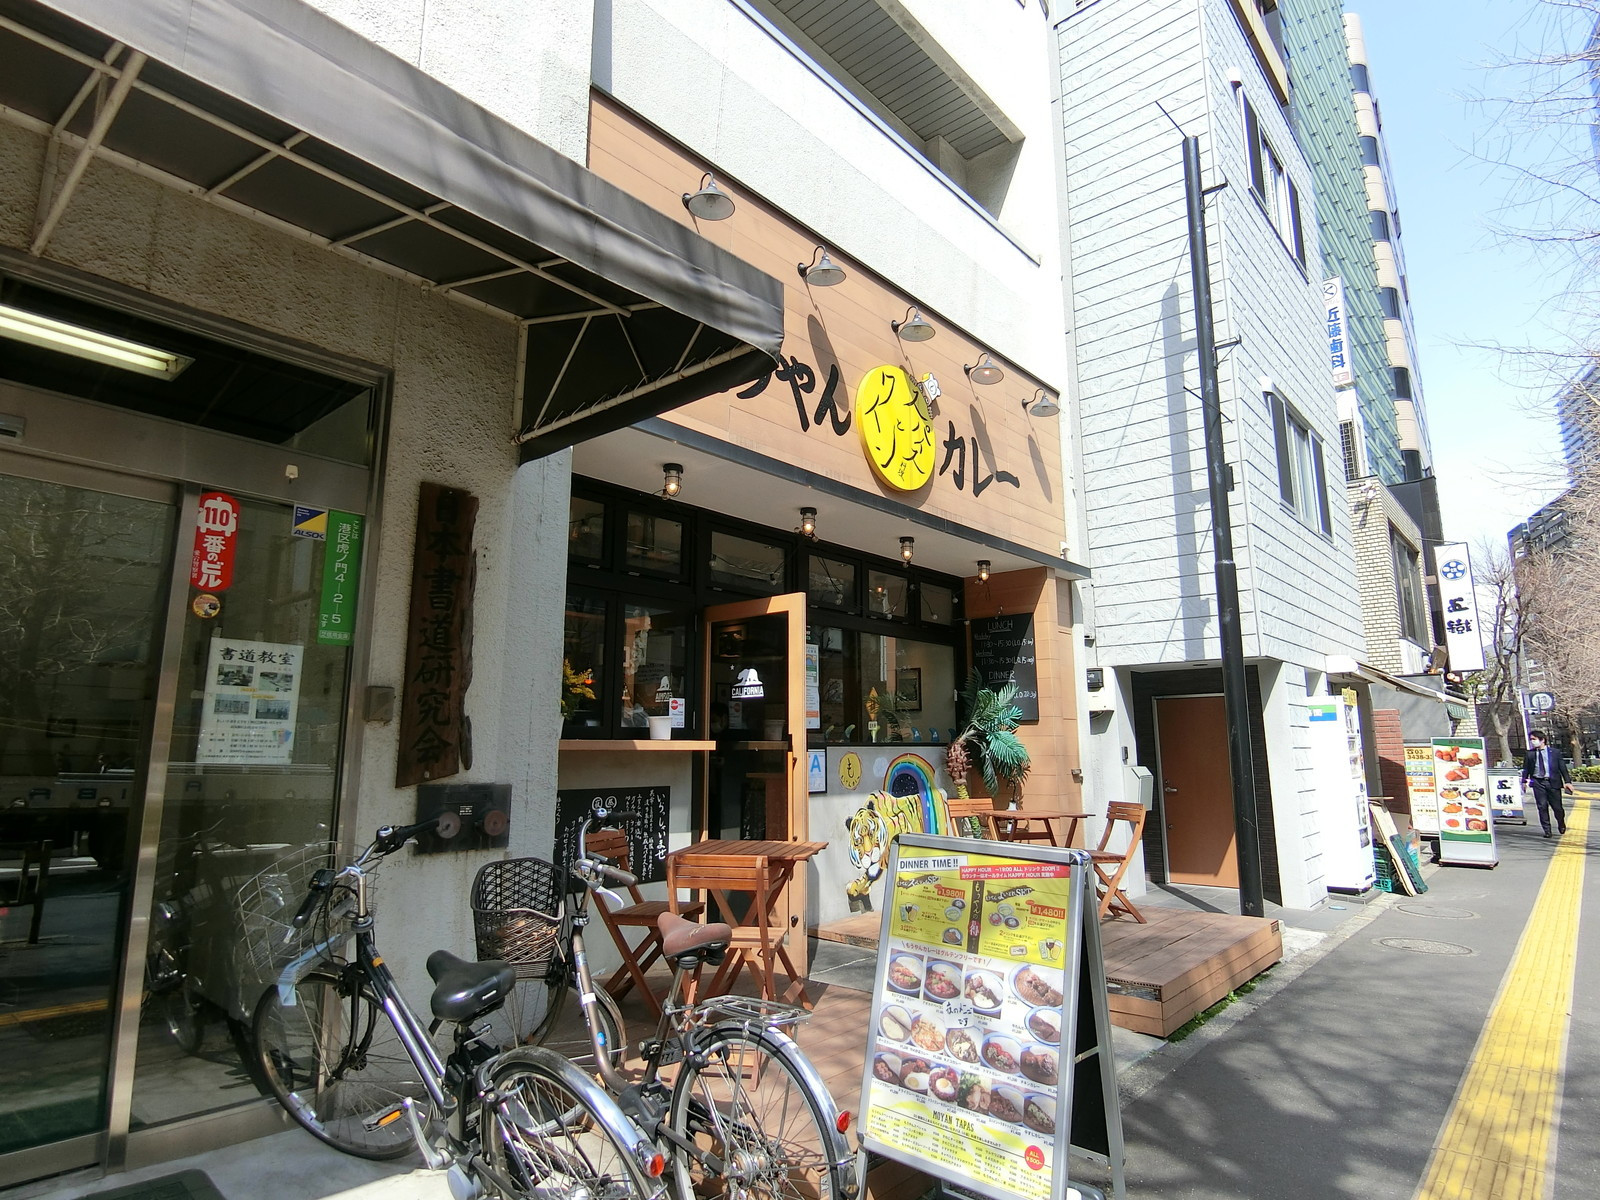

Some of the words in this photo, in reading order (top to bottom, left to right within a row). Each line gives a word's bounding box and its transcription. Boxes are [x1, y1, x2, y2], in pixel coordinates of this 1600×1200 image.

[939, 420, 1020, 498] カレー
[294, 530, 325, 539] ALSOK
[351, 520, 360, 540] ここは
[320, 614, 329, 627] です
[987, 619, 1013, 630] LUNCH
[219, 646, 296, 666] 書道教室
[989, 670, 1015, 680] DINNER
[732, 685, 764, 696] CALIFORNIA
[655, 793, 667, 860] いらっしゃいませ
[900, 860, 929, 869] DINNER
[932, 1110, 953, 1125] MOYAN
[956, 1118, 975, 1132] TAPAS
